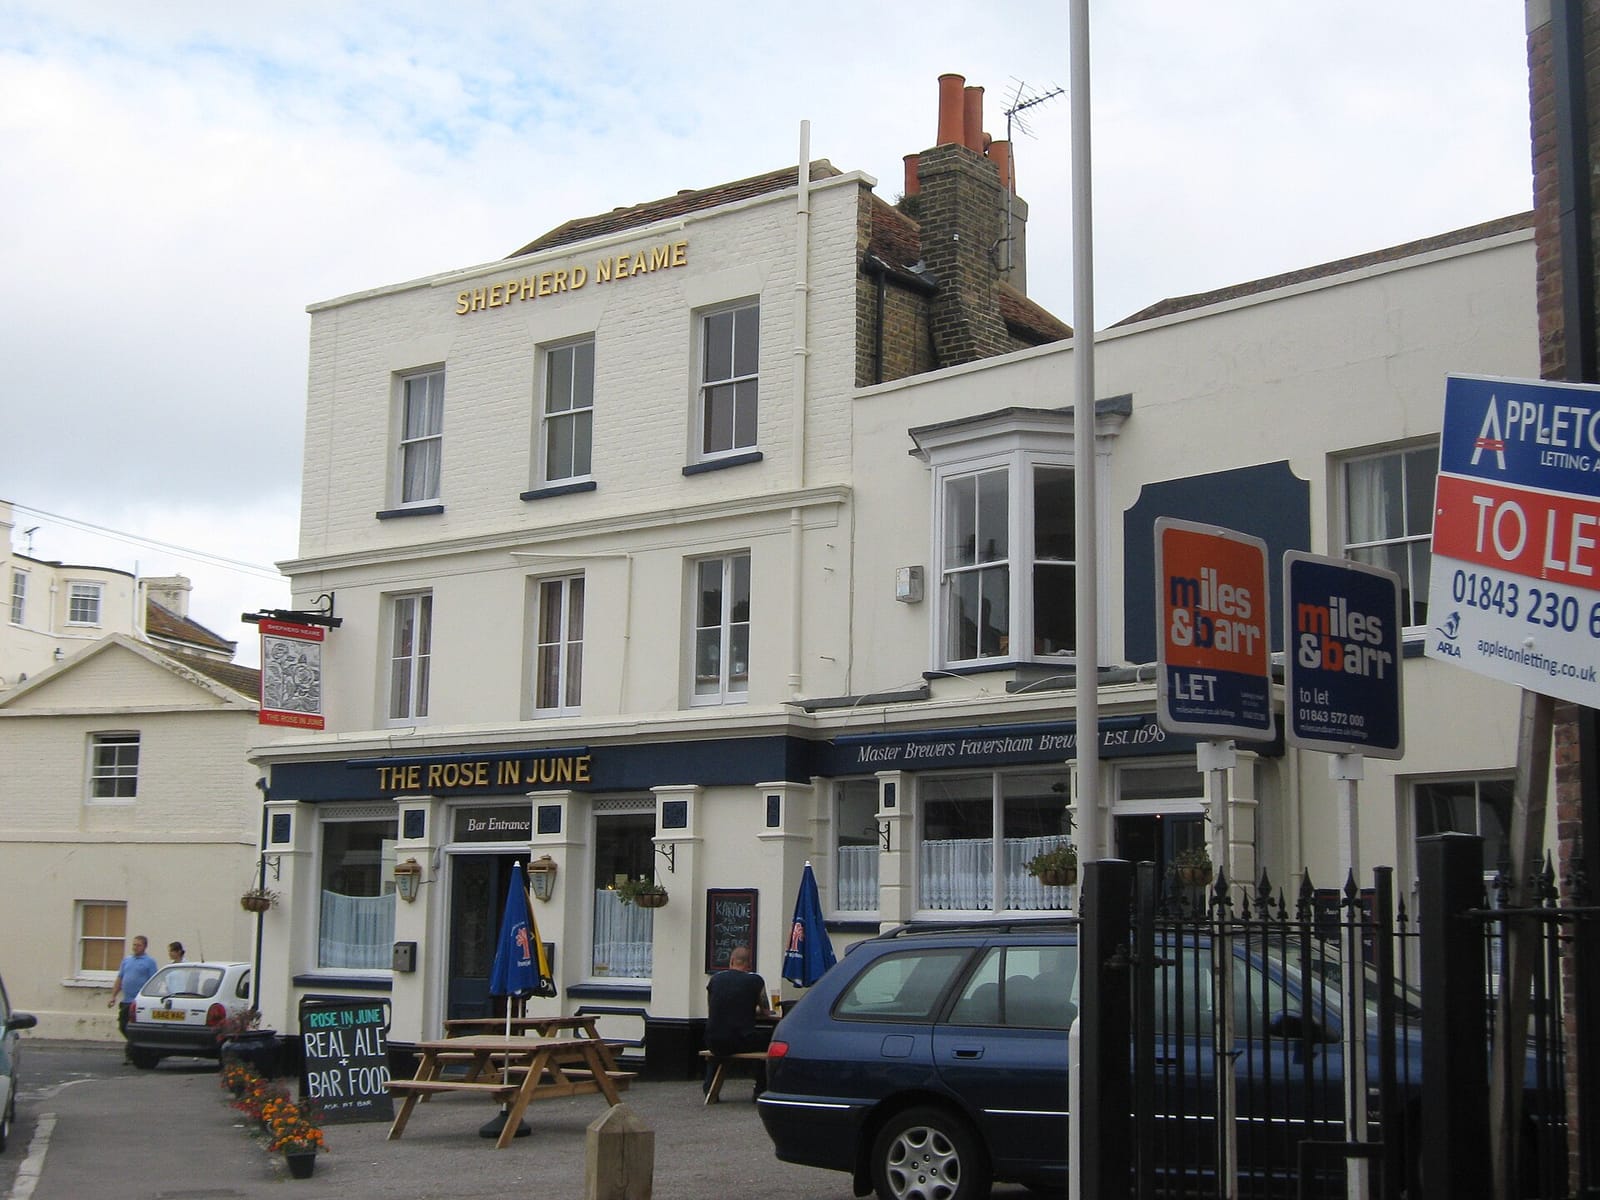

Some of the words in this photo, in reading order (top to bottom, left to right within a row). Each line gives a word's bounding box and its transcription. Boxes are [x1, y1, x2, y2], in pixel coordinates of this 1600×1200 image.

[456, 265, 588, 315] SHEPHERD
[596, 240, 689, 284] NEAME
[1540, 451, 1590, 472] LETTING
[1472, 495, 1528, 561] TO
[1543, 509, 1600, 577] LE
[1170, 566, 1252, 620] miles
[1453, 569, 1520, 618] 01843
[1526, 588, 1580, 633] 230
[1170, 608, 1261, 656] &barr
[1298, 596, 1384, 645] miles
[1298, 633, 1393, 680] &barr
[1436, 641, 1462, 658] ARLA
[1477, 639, 1597, 683] appletonletting.co.uk
[1174, 672, 1218, 702] LET
[1300, 687, 1311, 703] to
[1314, 687, 1329, 705] let
[1300, 708, 1329, 722] 01843
[1330, 712, 1348, 725] 572
[857, 745, 901, 763] Master
[904, 741, 956, 759] Brewers
[959, 736, 1033, 756] Faversham
[376, 765, 422, 791] THE
[428, 761, 490, 788] ROSE
[497, 760, 521, 785] IN
[526, 755, 592, 784] JUNE
[467, 818, 486, 832] Bar
[488, 817, 530, 831] Entrance
[310, 1012, 339, 1028] ROSE
[340, 1010, 354, 1025] IN
[355, 1008, 382, 1024] JUNE
[304, 1030, 351, 1058] REAL
[354, 1026, 386, 1057] ALE
[308, 1069, 344, 1098] BAR
[348, 1065, 391, 1097] FOOD
